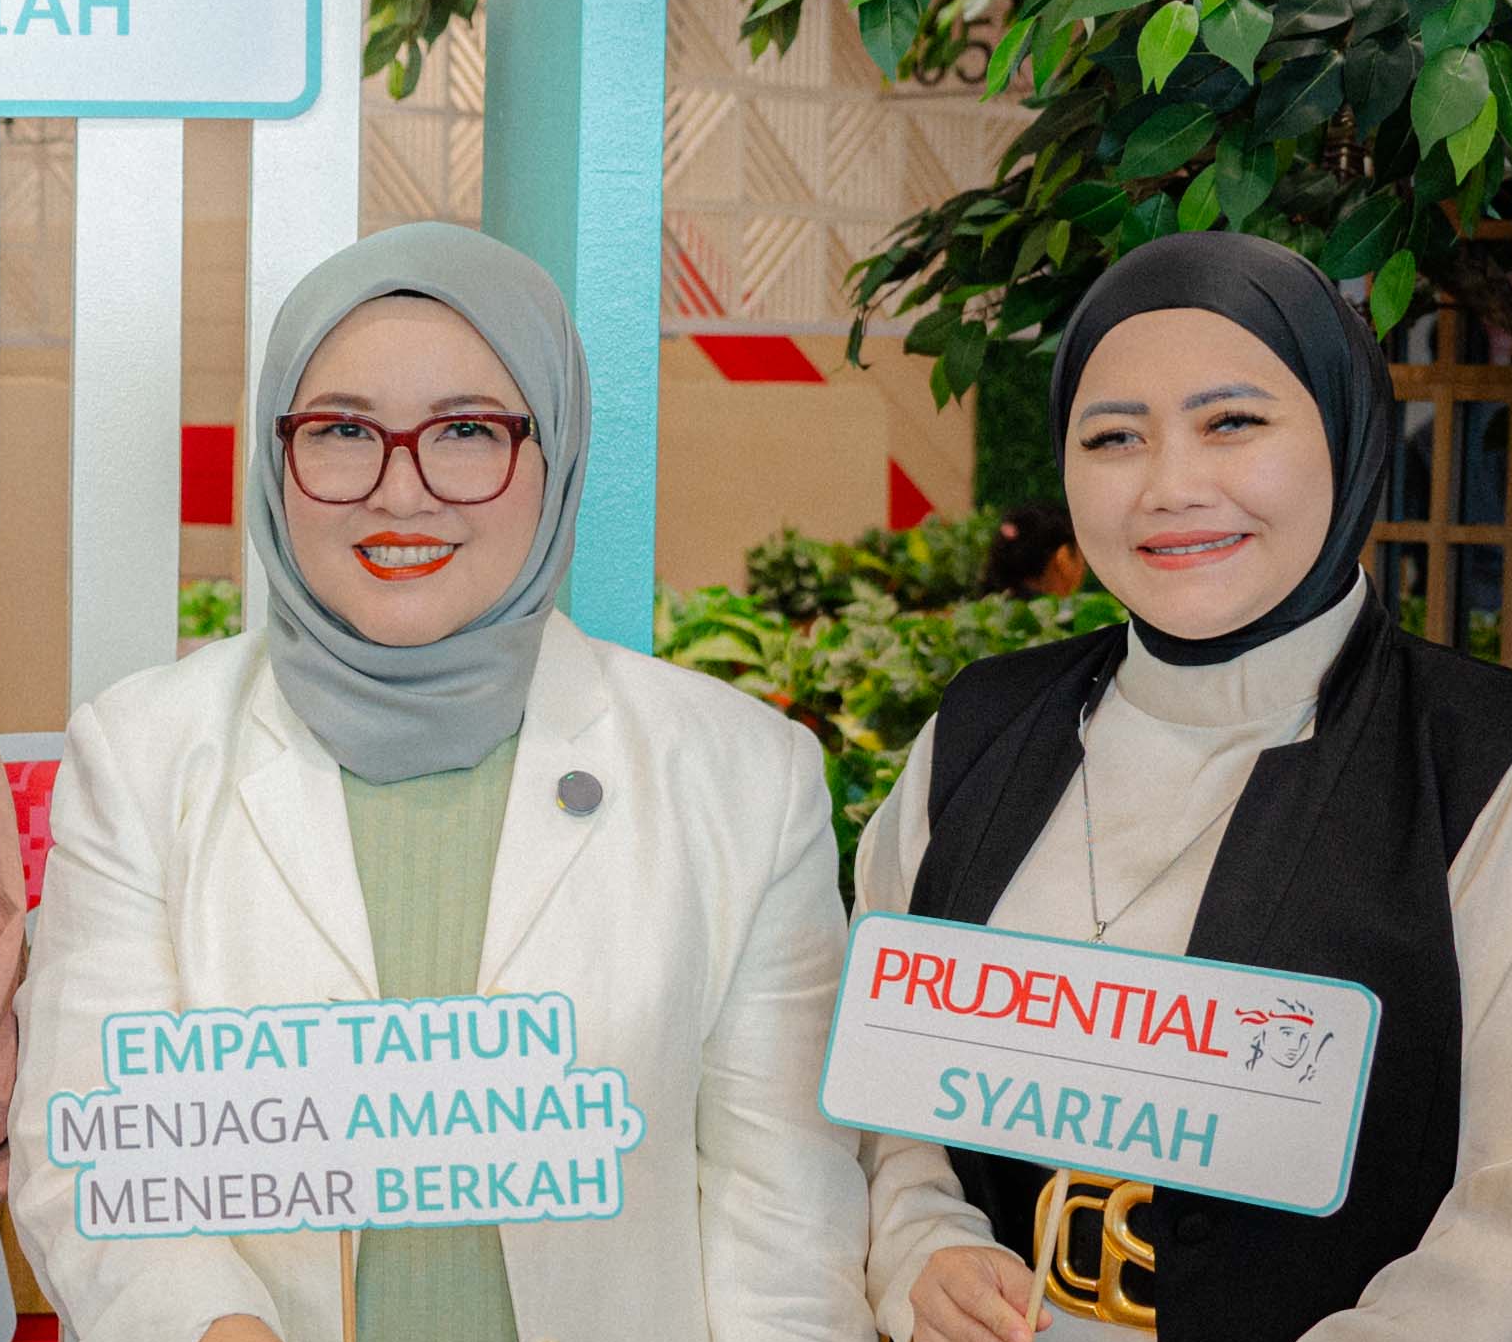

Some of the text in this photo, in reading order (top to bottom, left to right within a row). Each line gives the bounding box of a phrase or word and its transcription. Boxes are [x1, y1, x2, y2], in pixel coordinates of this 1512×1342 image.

[869, 946, 1230, 1059] PRUDENTIAL
[116, 1007, 561, 1076] EMPAT TAHUN
[61, 1083, 631, 1153] MENJAGA AMANAH,
[932, 1066, 1220, 1168] SYARIAH
[90, 1158, 608, 1225] MENEBAR BERKAH
